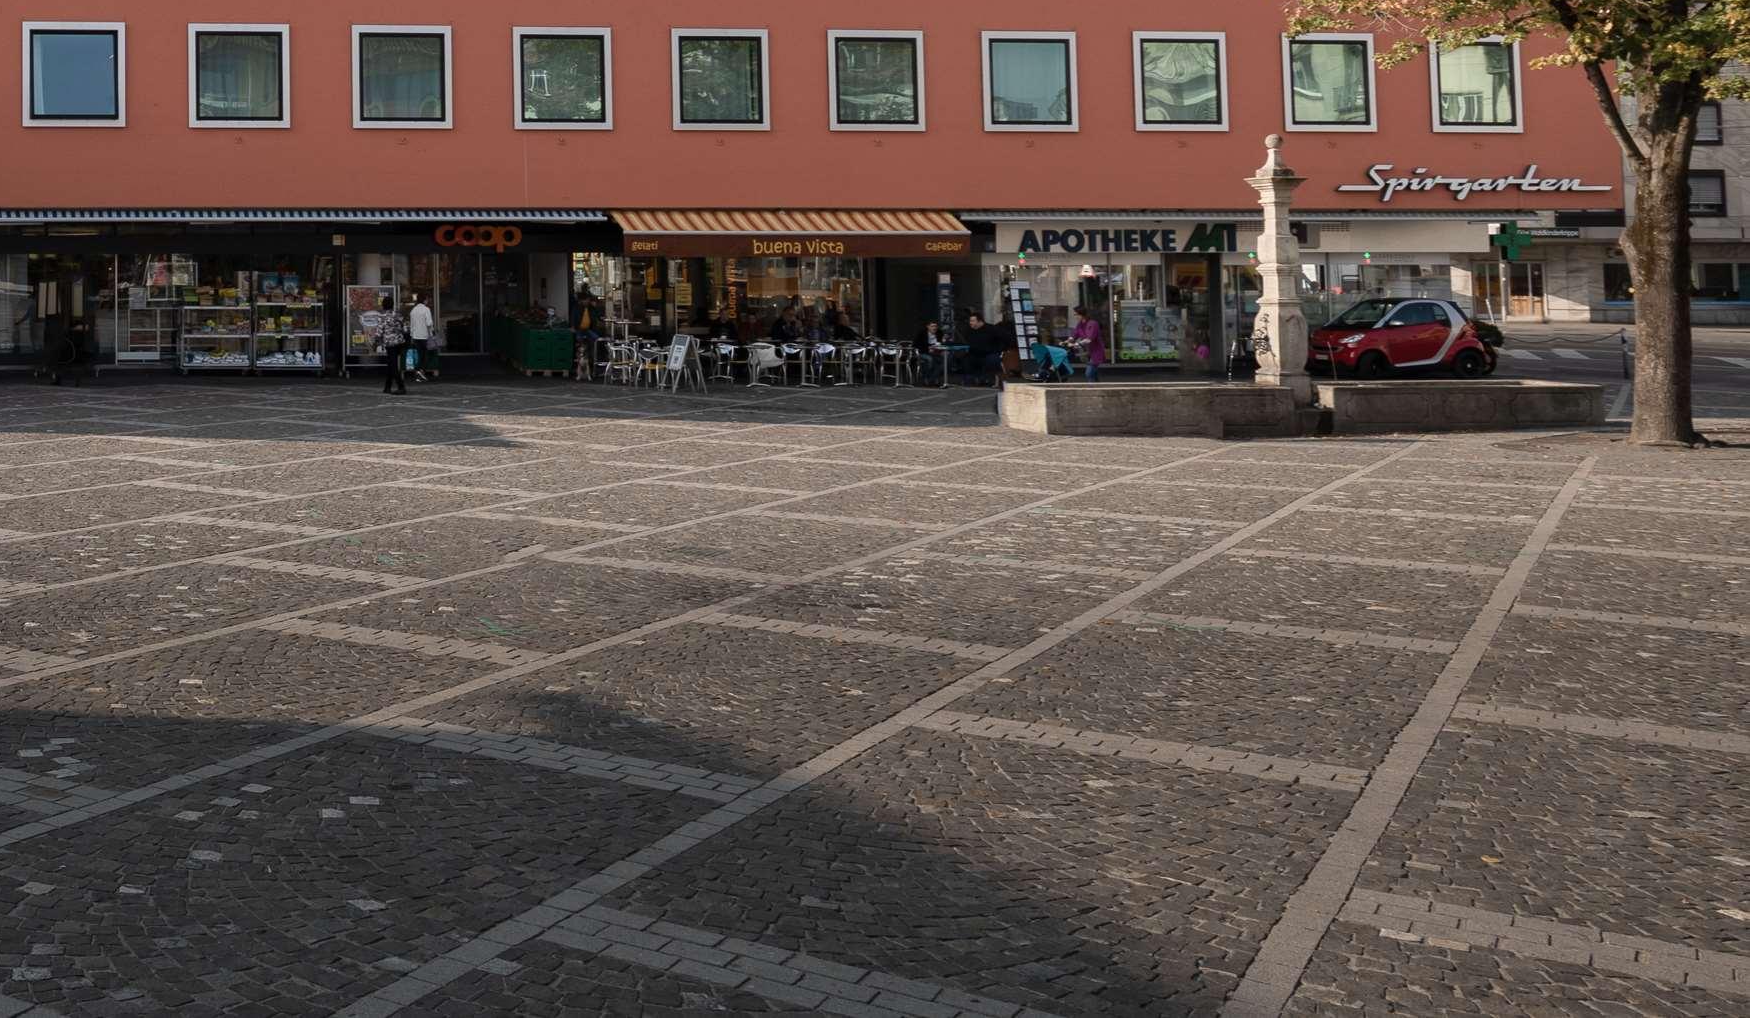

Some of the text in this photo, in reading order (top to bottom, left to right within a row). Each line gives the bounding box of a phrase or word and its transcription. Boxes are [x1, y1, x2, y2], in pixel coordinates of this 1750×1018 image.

[1337, 164, 1612, 202] Spirgarten
[435, 225, 523, 253] coop
[753, 239, 844, 255] buena vista
[1018, 228, 1177, 253] APOTHEKE
